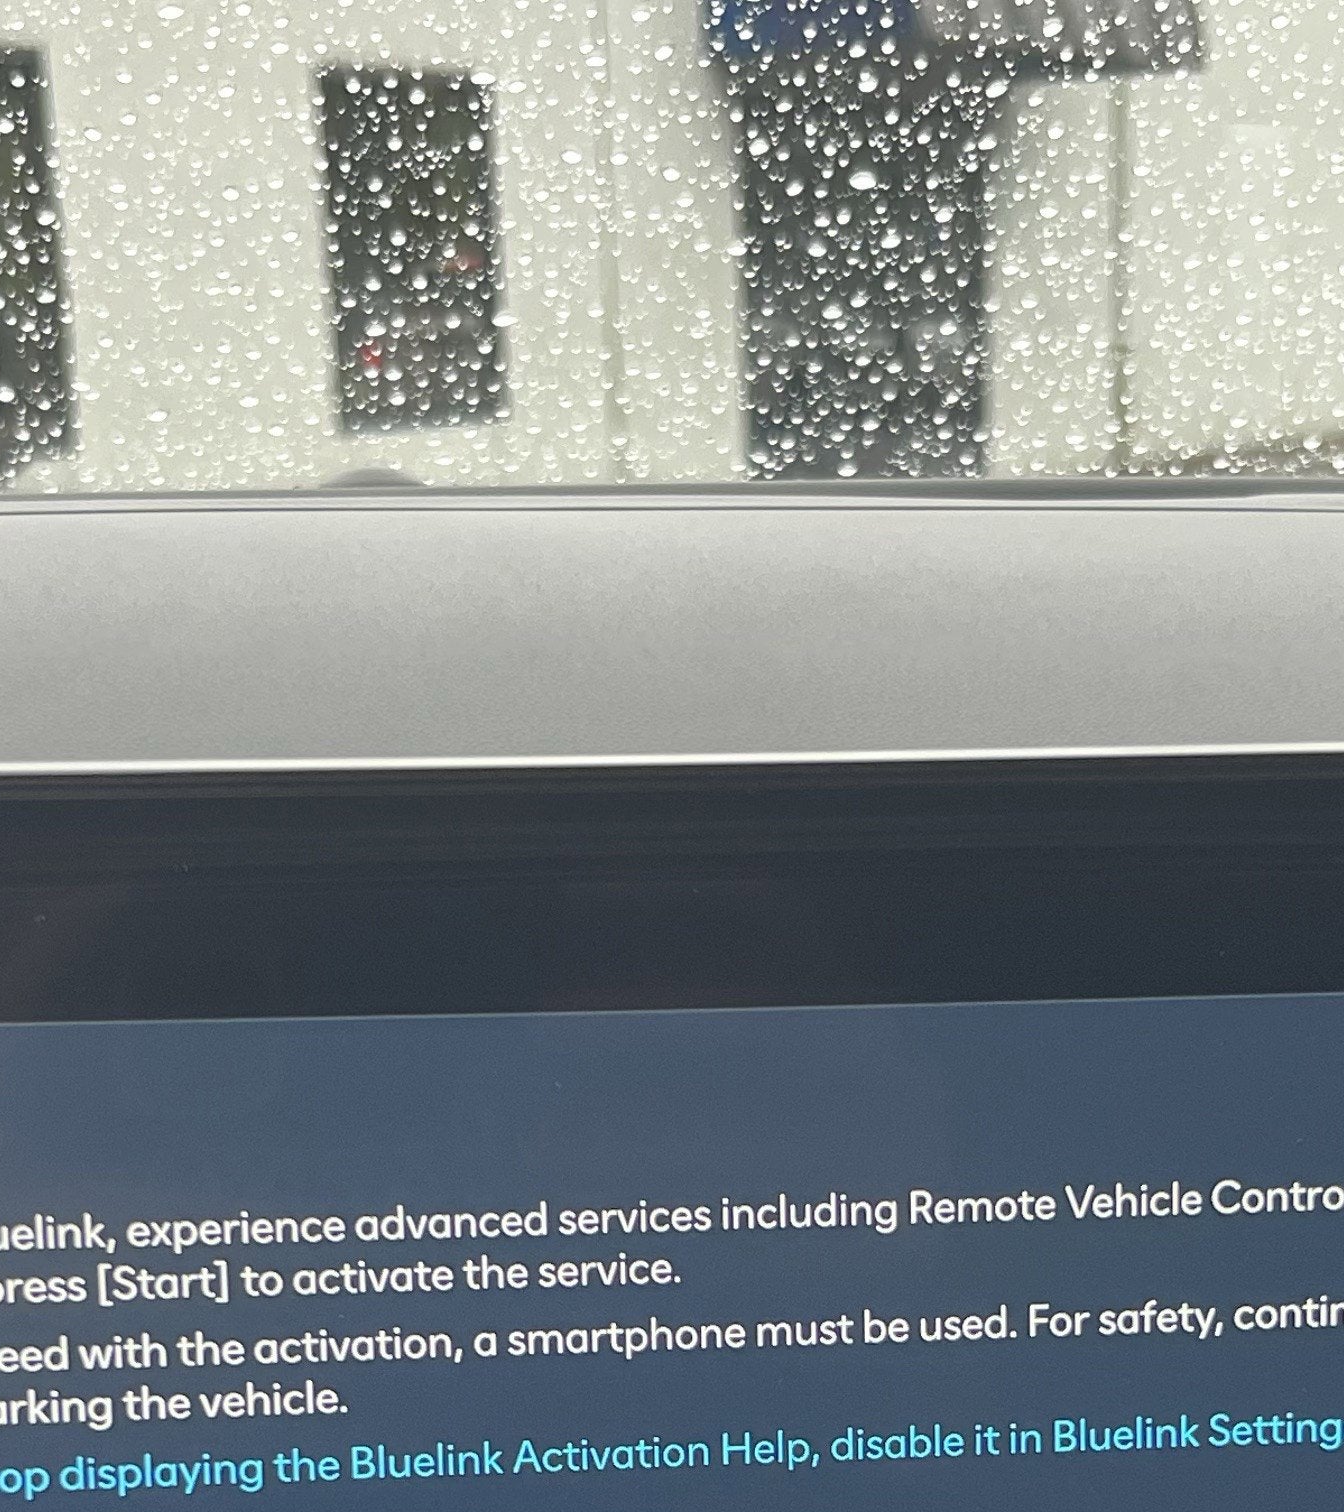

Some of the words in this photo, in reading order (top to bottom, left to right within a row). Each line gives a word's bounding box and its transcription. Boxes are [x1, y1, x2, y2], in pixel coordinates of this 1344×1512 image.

[125, 1209, 347, 1256] experience
[353, 1199, 549, 1242] advanced
[557, 1198, 713, 1237] services
[720, 1191, 899, 1235] including
[909, 1189, 1057, 1226] Remote
[1063, 1179, 1204, 1220] Vehicle
[96, 1258, 230, 1308] [Start]
[238, 1265, 285, 1298] to
[291, 1259, 455, 1297] activate
[460, 1253, 530, 1291] the
[537, 1251, 682, 1289] service.
[77, 1330, 169, 1371] with
[175, 1329, 246, 1368] the
[252, 1325, 464, 1366] activation,
[472, 1331, 499, 1359] a
[506, 1315, 747, 1361] smartphone
[755, 1313, 856, 1348] must
[862, 1307, 911, 1345] be
[919, 1303, 1019, 1343] used.
[1028, 1302, 1092, 1339] For
[1097, 1298, 1225, 1341] safety,
[120, 1383, 193, 1422] the
[198, 1378, 349, 1419] vehicle.
[58, 1451, 265, 1498] displaying
[271, 1446, 342, 1484] the
[350, 1439, 505, 1481] Bluelink
[512, 1435, 711, 1475] Activation
[721, 1428, 821, 1472] Help,
[829, 1422, 966, 1462] disable
[973, 1422, 1002, 1457] it
[1009, 1421, 1043, 1455] in
[1053, 1413, 1201, 1454] Bluelink
